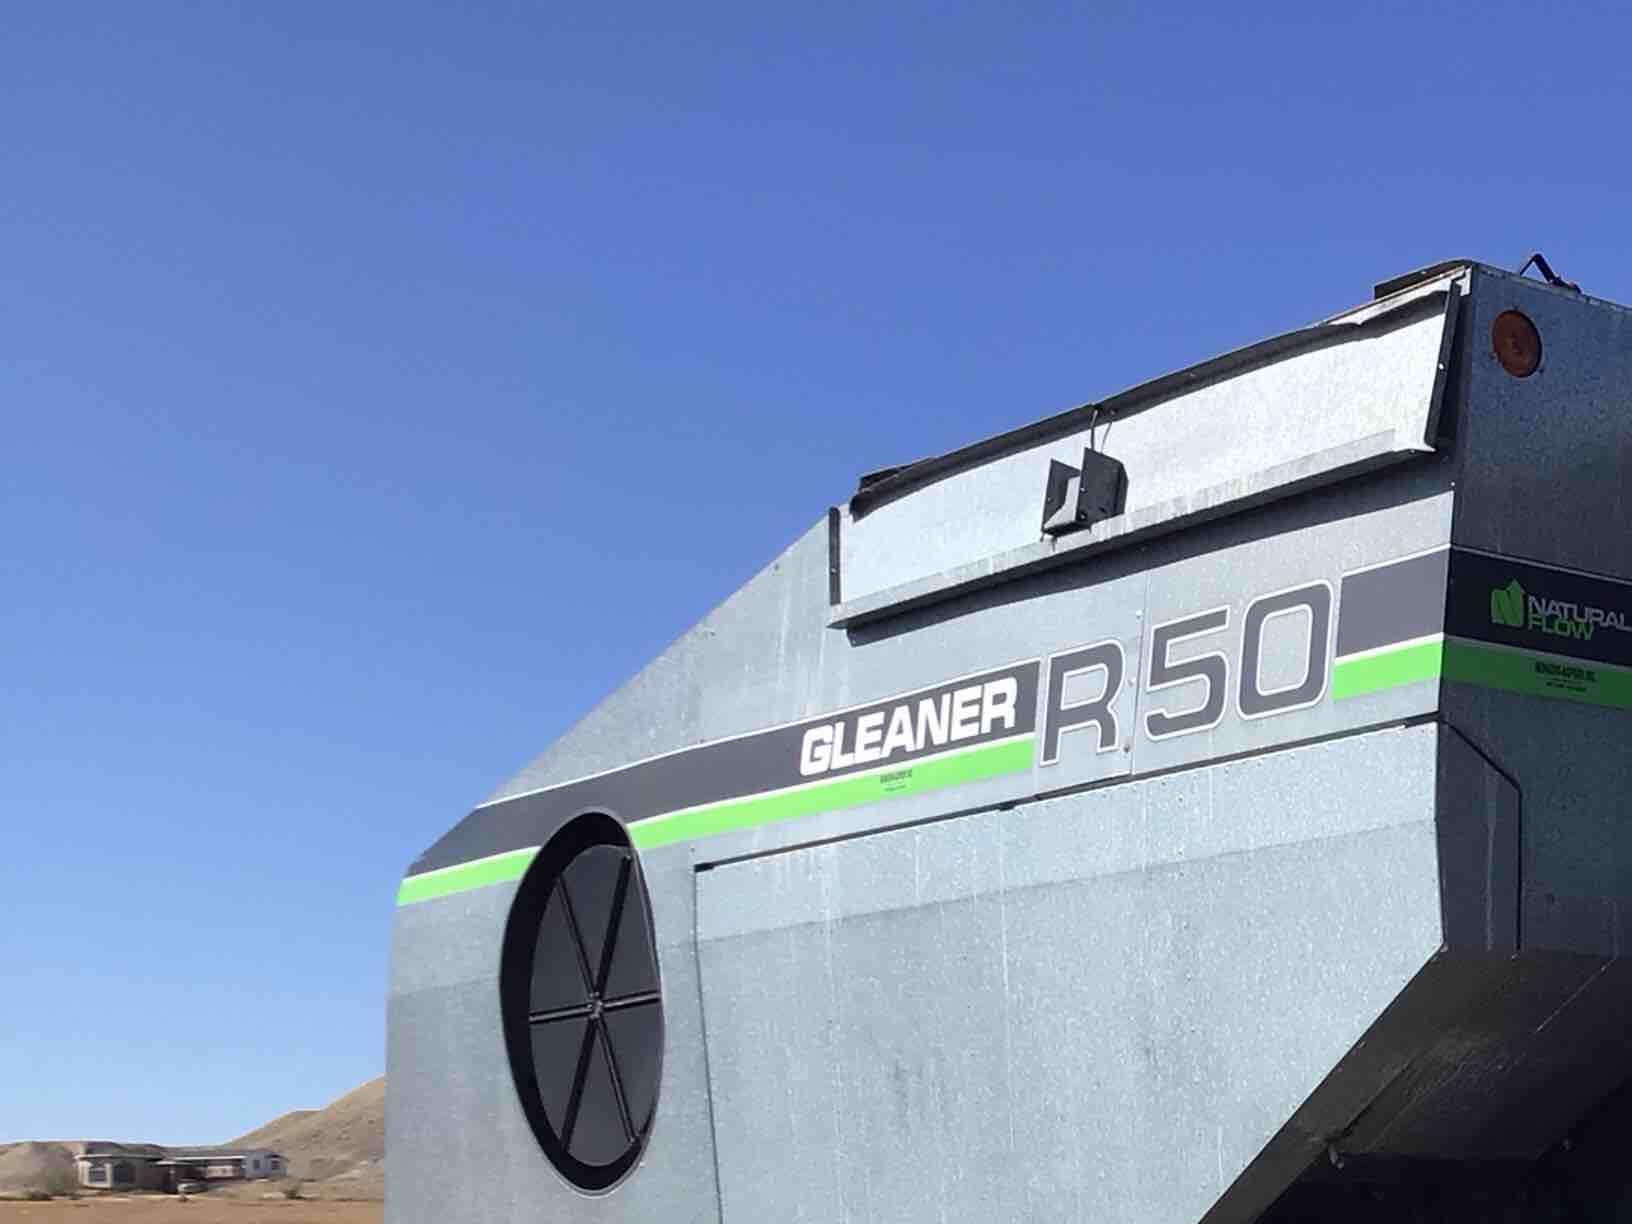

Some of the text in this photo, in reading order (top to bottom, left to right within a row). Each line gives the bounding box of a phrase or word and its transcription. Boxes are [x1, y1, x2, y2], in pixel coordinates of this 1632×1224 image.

[1527, 596, 1632, 632] NATURAL
[1527, 614, 1595, 641] FLOW
[799, 676, 1018, 777] GLEANER
